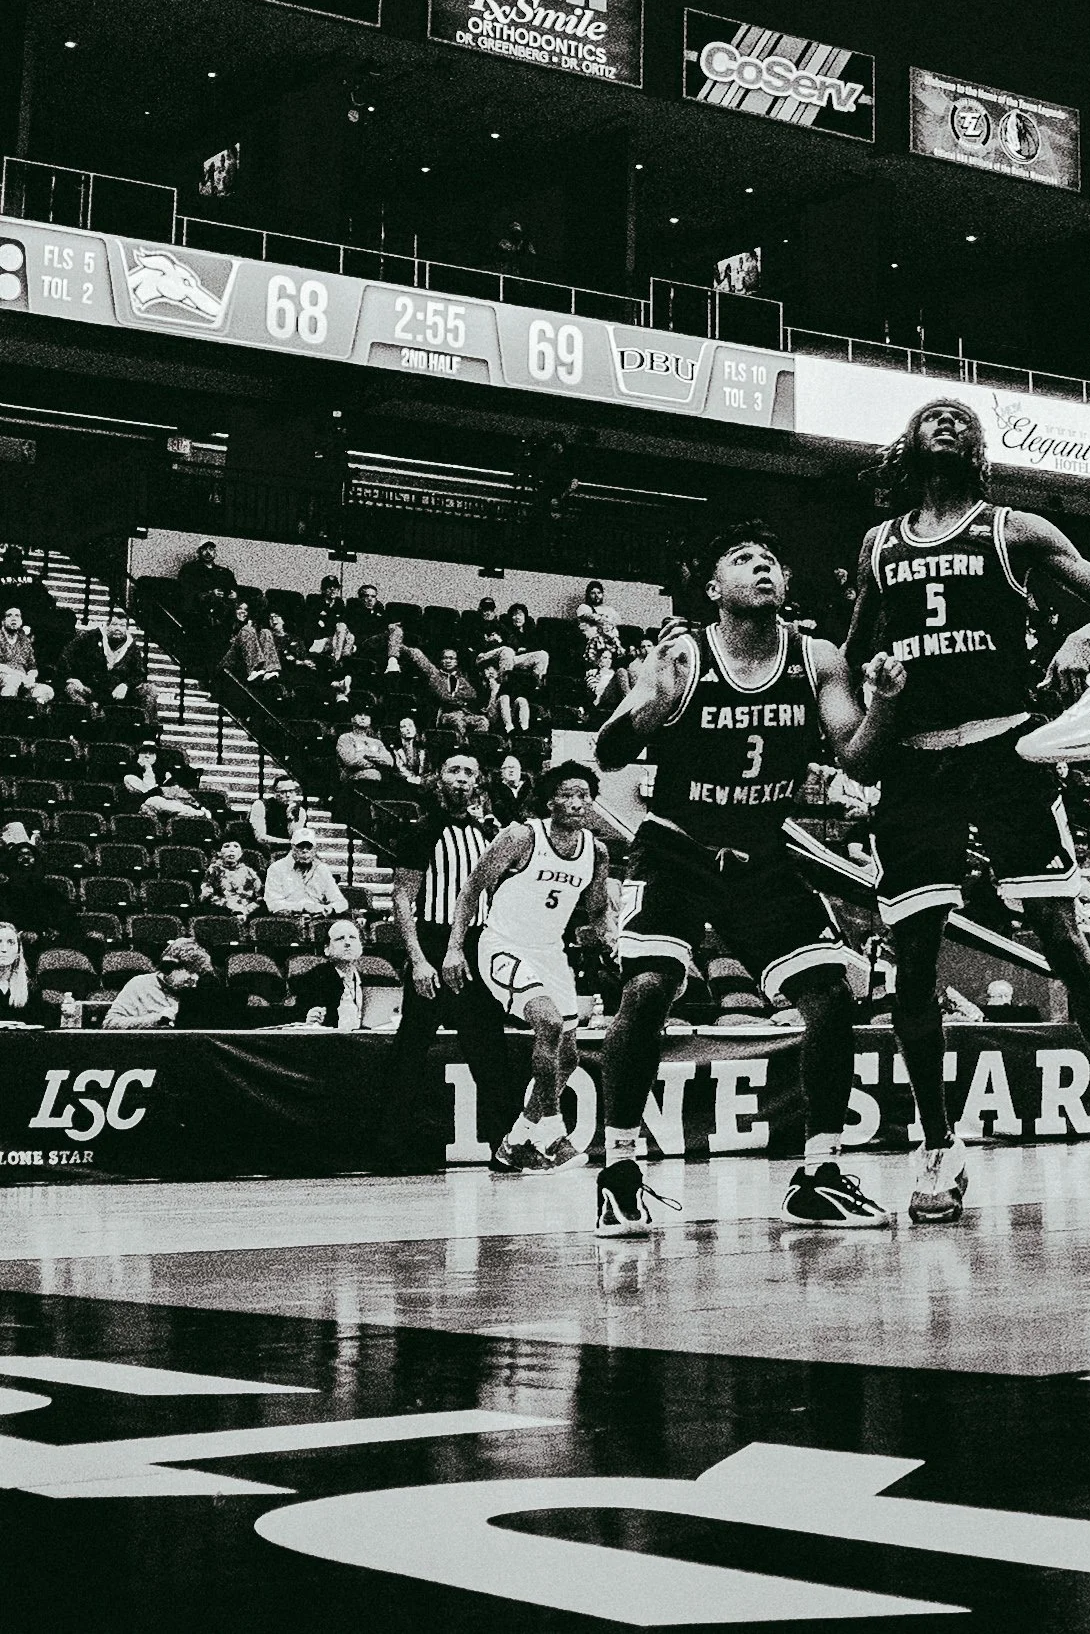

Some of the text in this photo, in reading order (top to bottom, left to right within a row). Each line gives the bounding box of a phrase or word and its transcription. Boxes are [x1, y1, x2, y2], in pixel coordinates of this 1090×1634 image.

[455, 30, 617, 80] DR. GREENBERG DR. ORTIZ
[467, 16, 608, 64] ORTHODONTICS
[43, 244, 96, 274] FLS 5
[41, 274, 94, 304] TOL 2
[265, 274, 329, 344] 68
[394, 295, 467, 349] 2:55
[399, 347, 462, 375] 2ND HALF
[528, 319, 584, 385] 69
[617, 347, 698, 383] DBU
[723, 360, 767, 386] FLS 10
[723, 387, 763, 412] TOL 3
[884, 553, 985, 586] EASTERN
[925, 582, 947, 627] 5
[700, 703, 806, 729] EASTERN
[741, 734, 765, 779] 3
[688, 780, 730, 806] NEW
[536, 869, 584, 888] DBU
[544, 889, 563, 910] 5
[28, 1068, 157, 1142] LSC
[0, 1150, 94, 1166] LONE STAR
